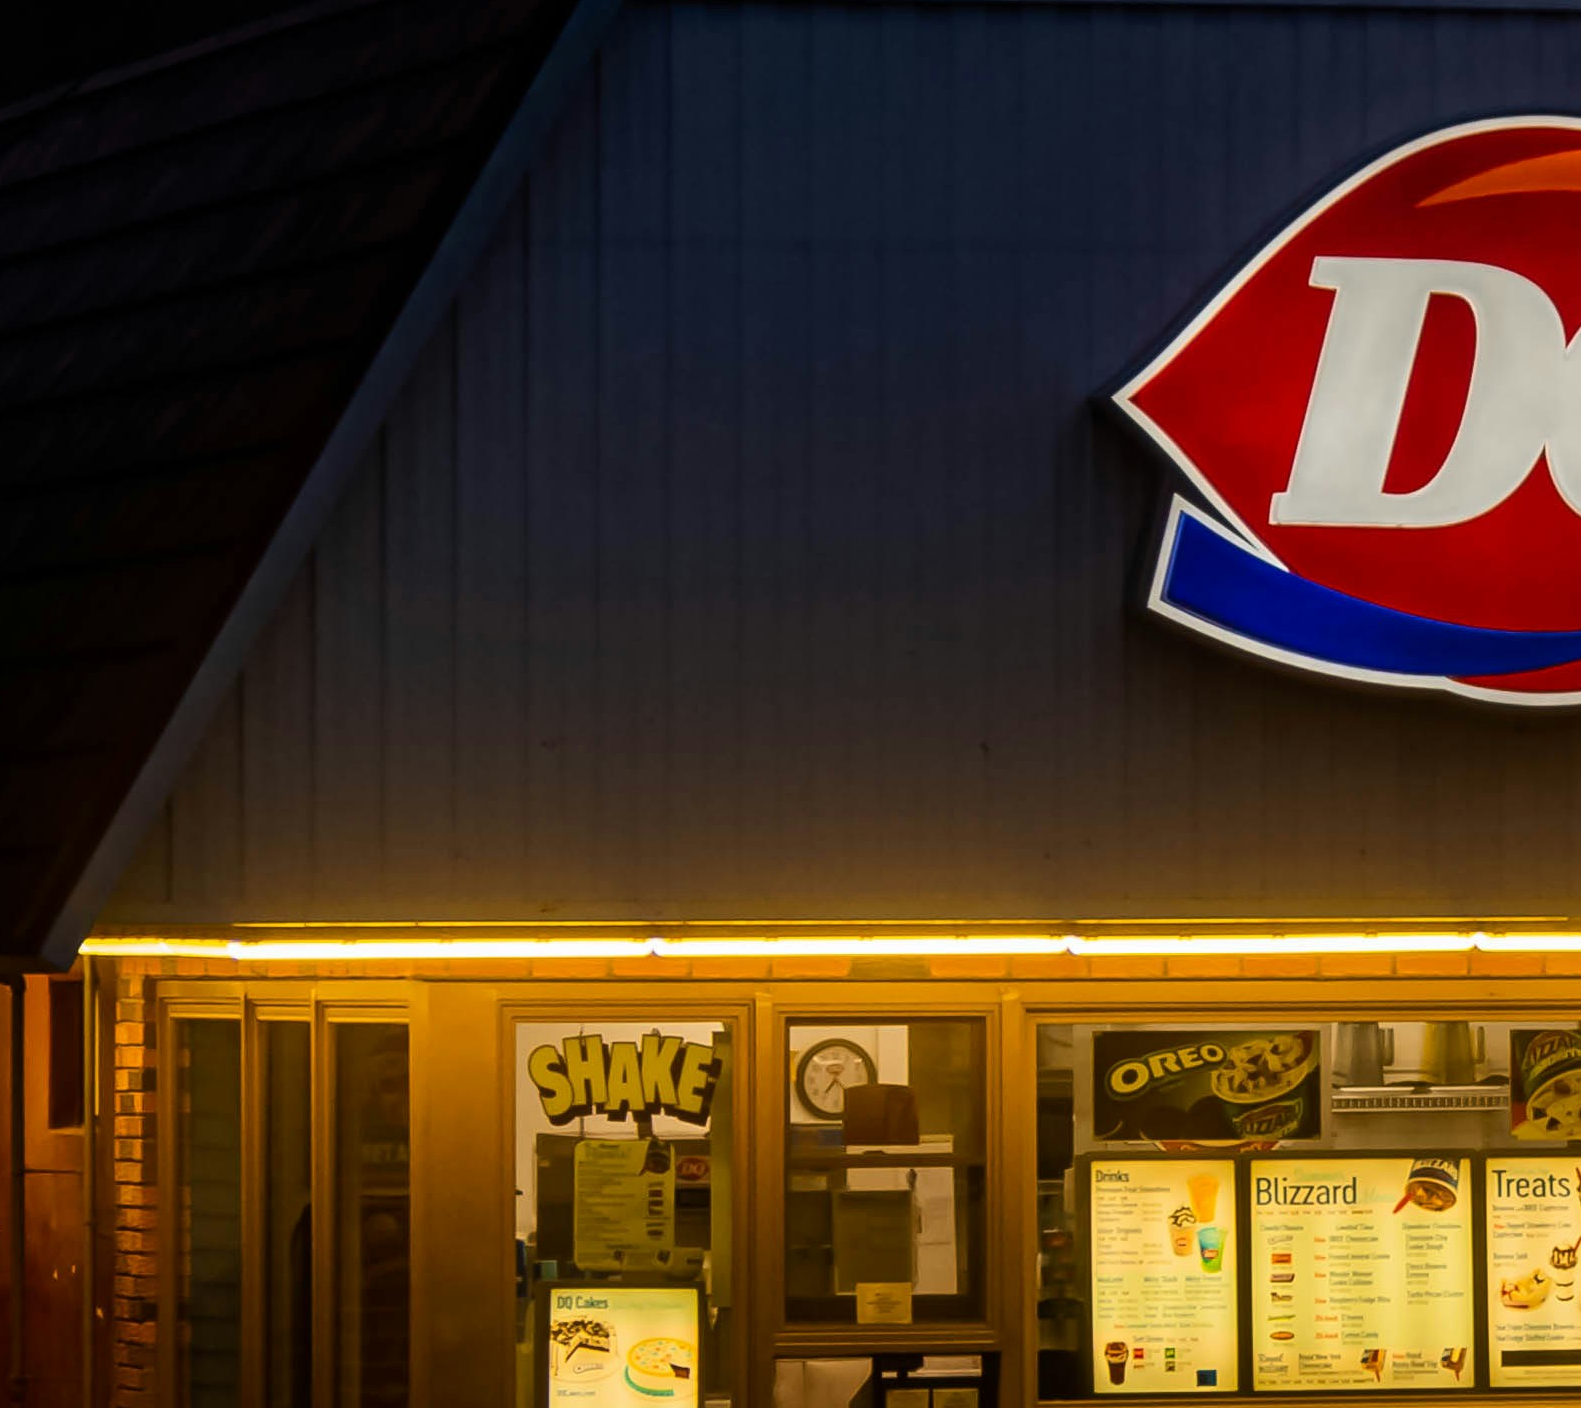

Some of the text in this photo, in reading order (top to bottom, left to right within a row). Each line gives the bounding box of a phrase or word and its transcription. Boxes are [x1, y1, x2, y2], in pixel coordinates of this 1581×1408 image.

[528, 1034, 721, 1124] SHAKE
[1110, 1044, 1224, 1093] OREO
[1096, 1169, 1130, 1183] Drinks
[1492, 1170, 1571, 1198] Treats
[1256, 1177, 1357, 1206] Blizzard
[575, 1296, 609, 1309] Cakes
